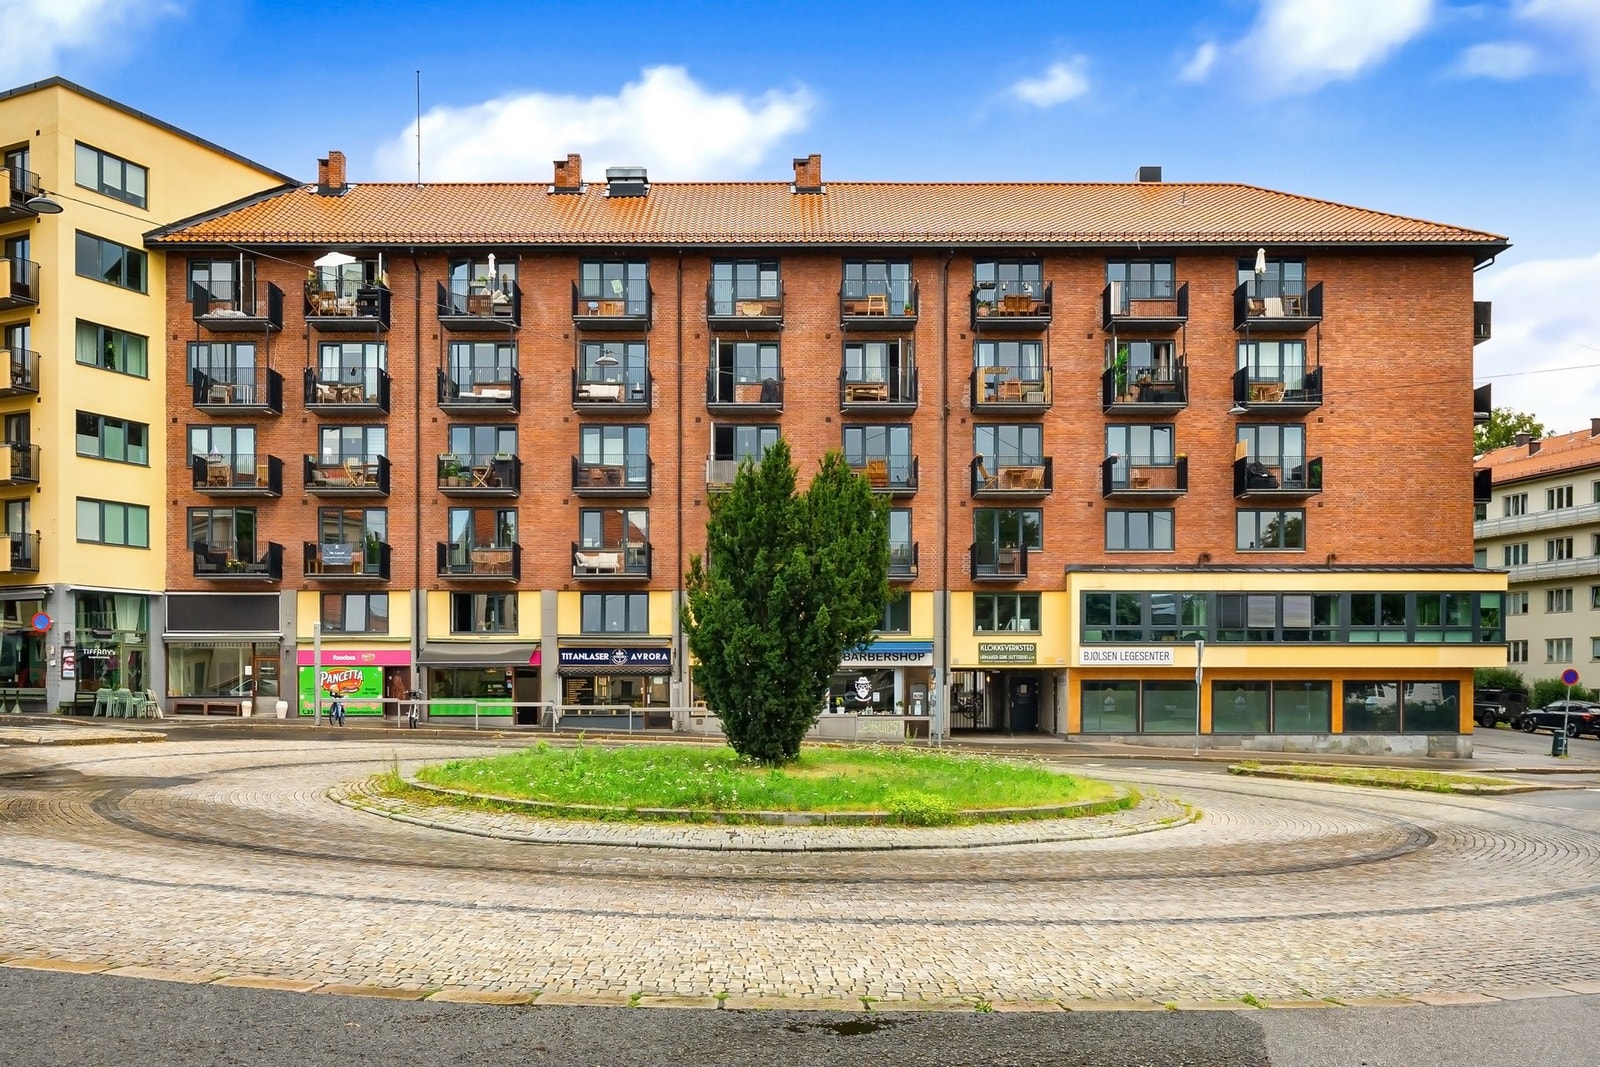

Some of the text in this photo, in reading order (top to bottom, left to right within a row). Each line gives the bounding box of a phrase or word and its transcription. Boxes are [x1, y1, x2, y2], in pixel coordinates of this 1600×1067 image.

[561, 652, 668, 660] TITANLASER AVRORA
[843, 652, 925, 662] BARBERSHOP
[1083, 651, 1170, 661] BJØLSEN LEGESENTER
[320, 669, 363, 686] PANCETTA
